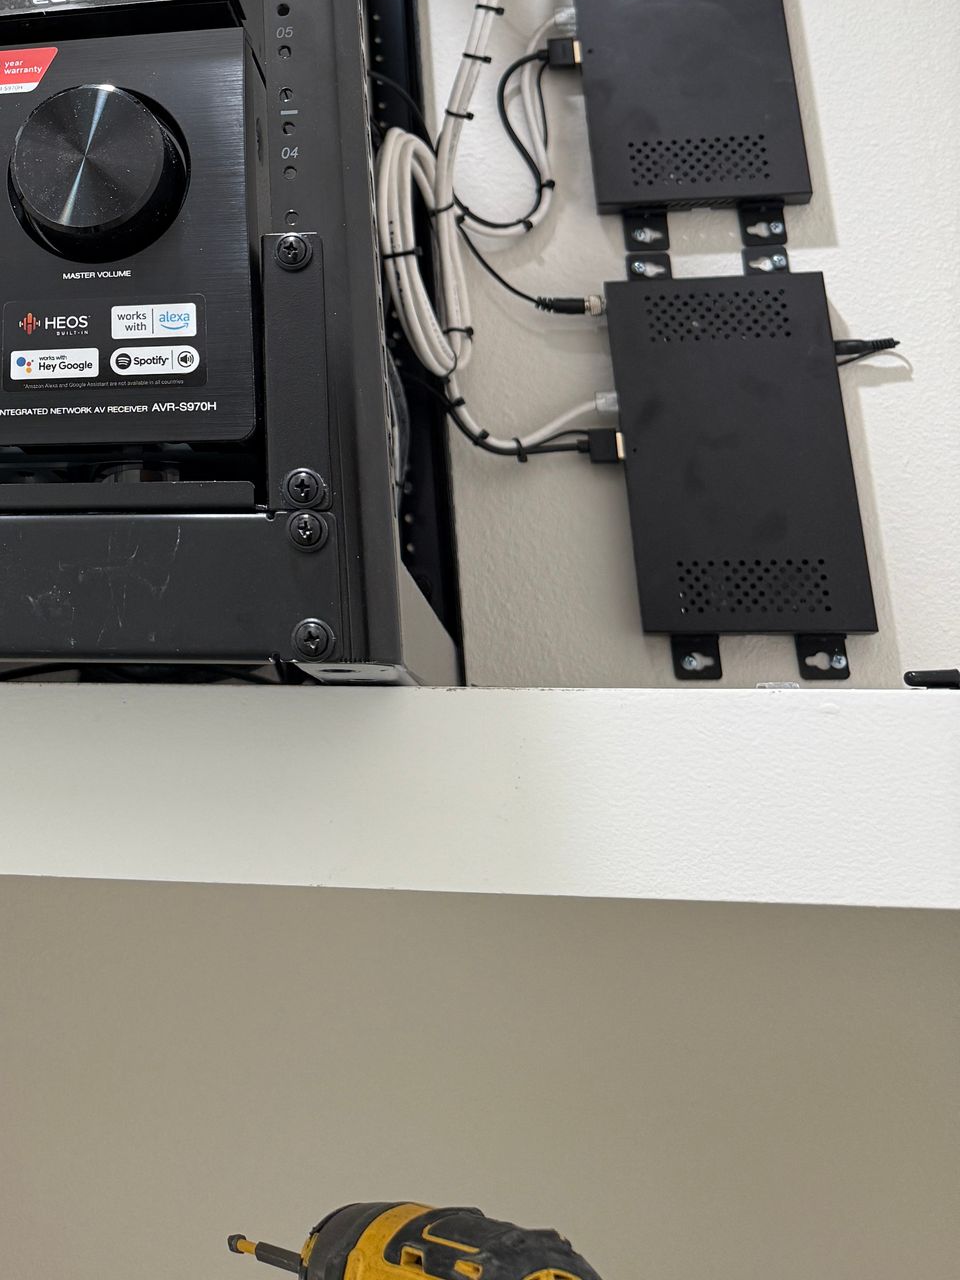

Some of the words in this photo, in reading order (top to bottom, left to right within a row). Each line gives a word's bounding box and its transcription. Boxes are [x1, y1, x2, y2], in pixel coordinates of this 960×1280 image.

[276, 26, 294, 39] 05
[4, 60, 23, 68] year
[4, 64, 42, 74] warranty
[280, 146, 299, 160] 04
[63, 272, 95, 280] MASTER
[97, 270, 131, 278] VOLUME
[117, 310, 147, 321] works
[158, 311, 190, 323] alexa
[44, 315, 89, 330] HEOS
[124, 322, 147, 332] with
[38, 361, 57, 373] Hey
[58, 360, 93, 372] Google
[133, 356, 167, 367] Spotify
[50, 406, 92, 414] NETWORK
[151, 401, 217, 412] AVR-S970H
